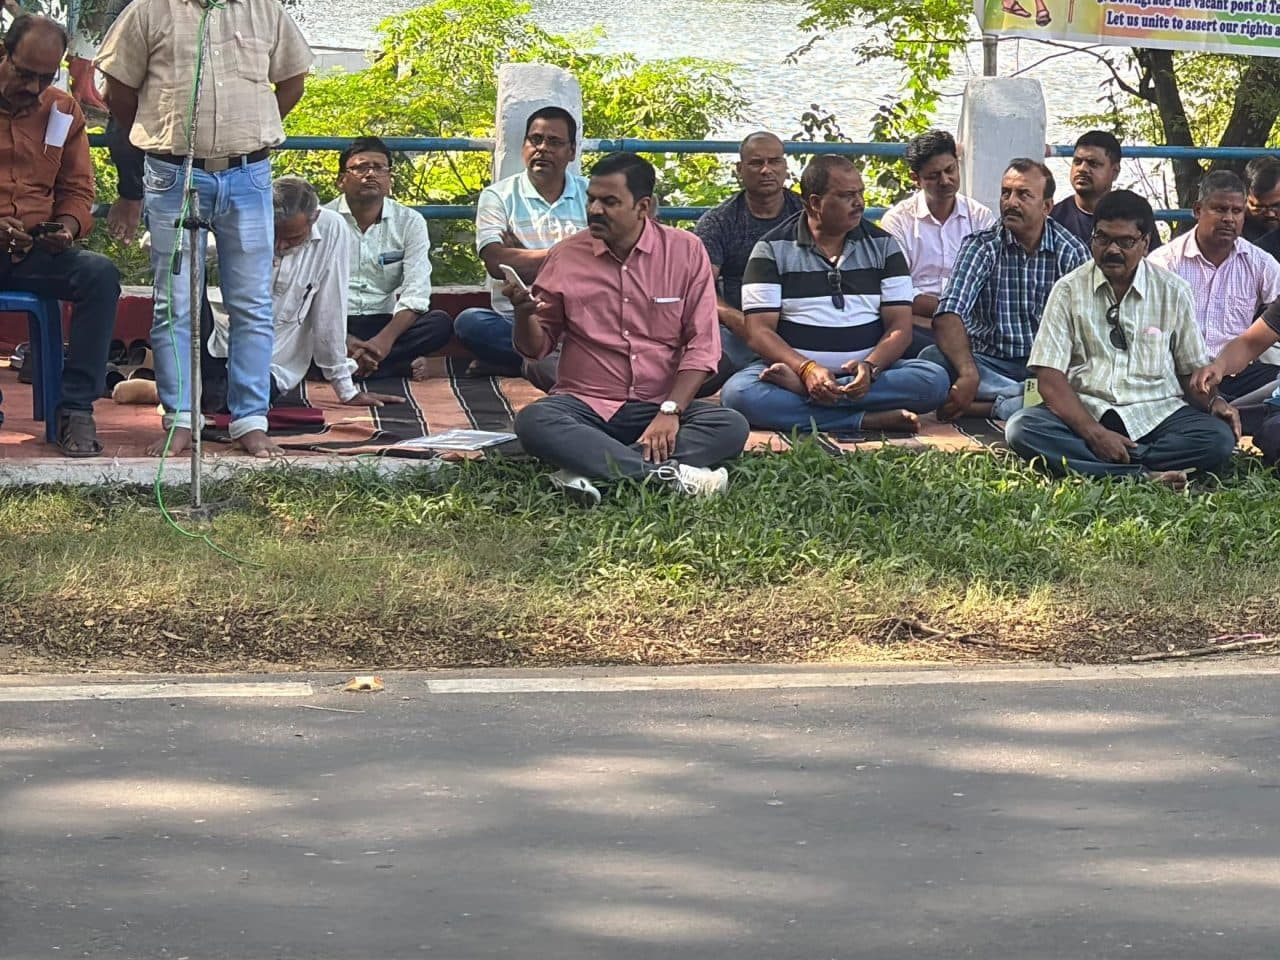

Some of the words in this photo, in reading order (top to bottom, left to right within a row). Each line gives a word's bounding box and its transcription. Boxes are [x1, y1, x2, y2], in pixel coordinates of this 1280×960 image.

[1230, 1, 1253, 14] post
[1256, 0, 1267, 12] of
[1106, 11, 1124, 25] Let
[1127, 15, 1139, 26] us
[1142, 14, 1169, 29] unite
[1172, 16, 1183, 29] to
[1185, 19, 1217, 32] assert
[1220, 22, 1238, 33] our
[1240, 21, 1273, 37] rights
